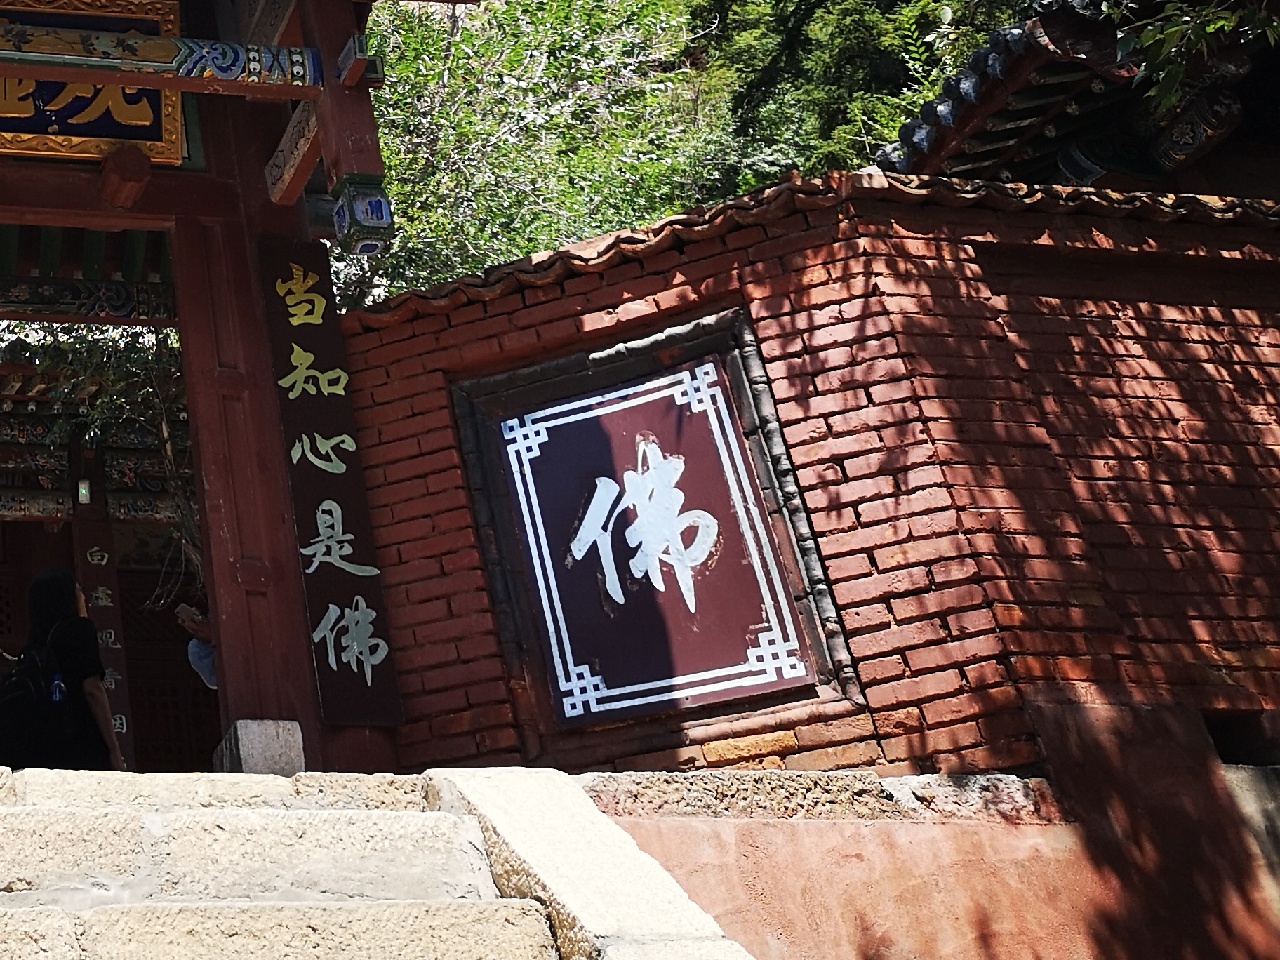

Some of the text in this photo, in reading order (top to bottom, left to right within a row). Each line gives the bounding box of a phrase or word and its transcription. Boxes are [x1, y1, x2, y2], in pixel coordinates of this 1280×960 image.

[275, 263, 389, 686] 当知心是佛
[569, 430, 719, 614] 佛
